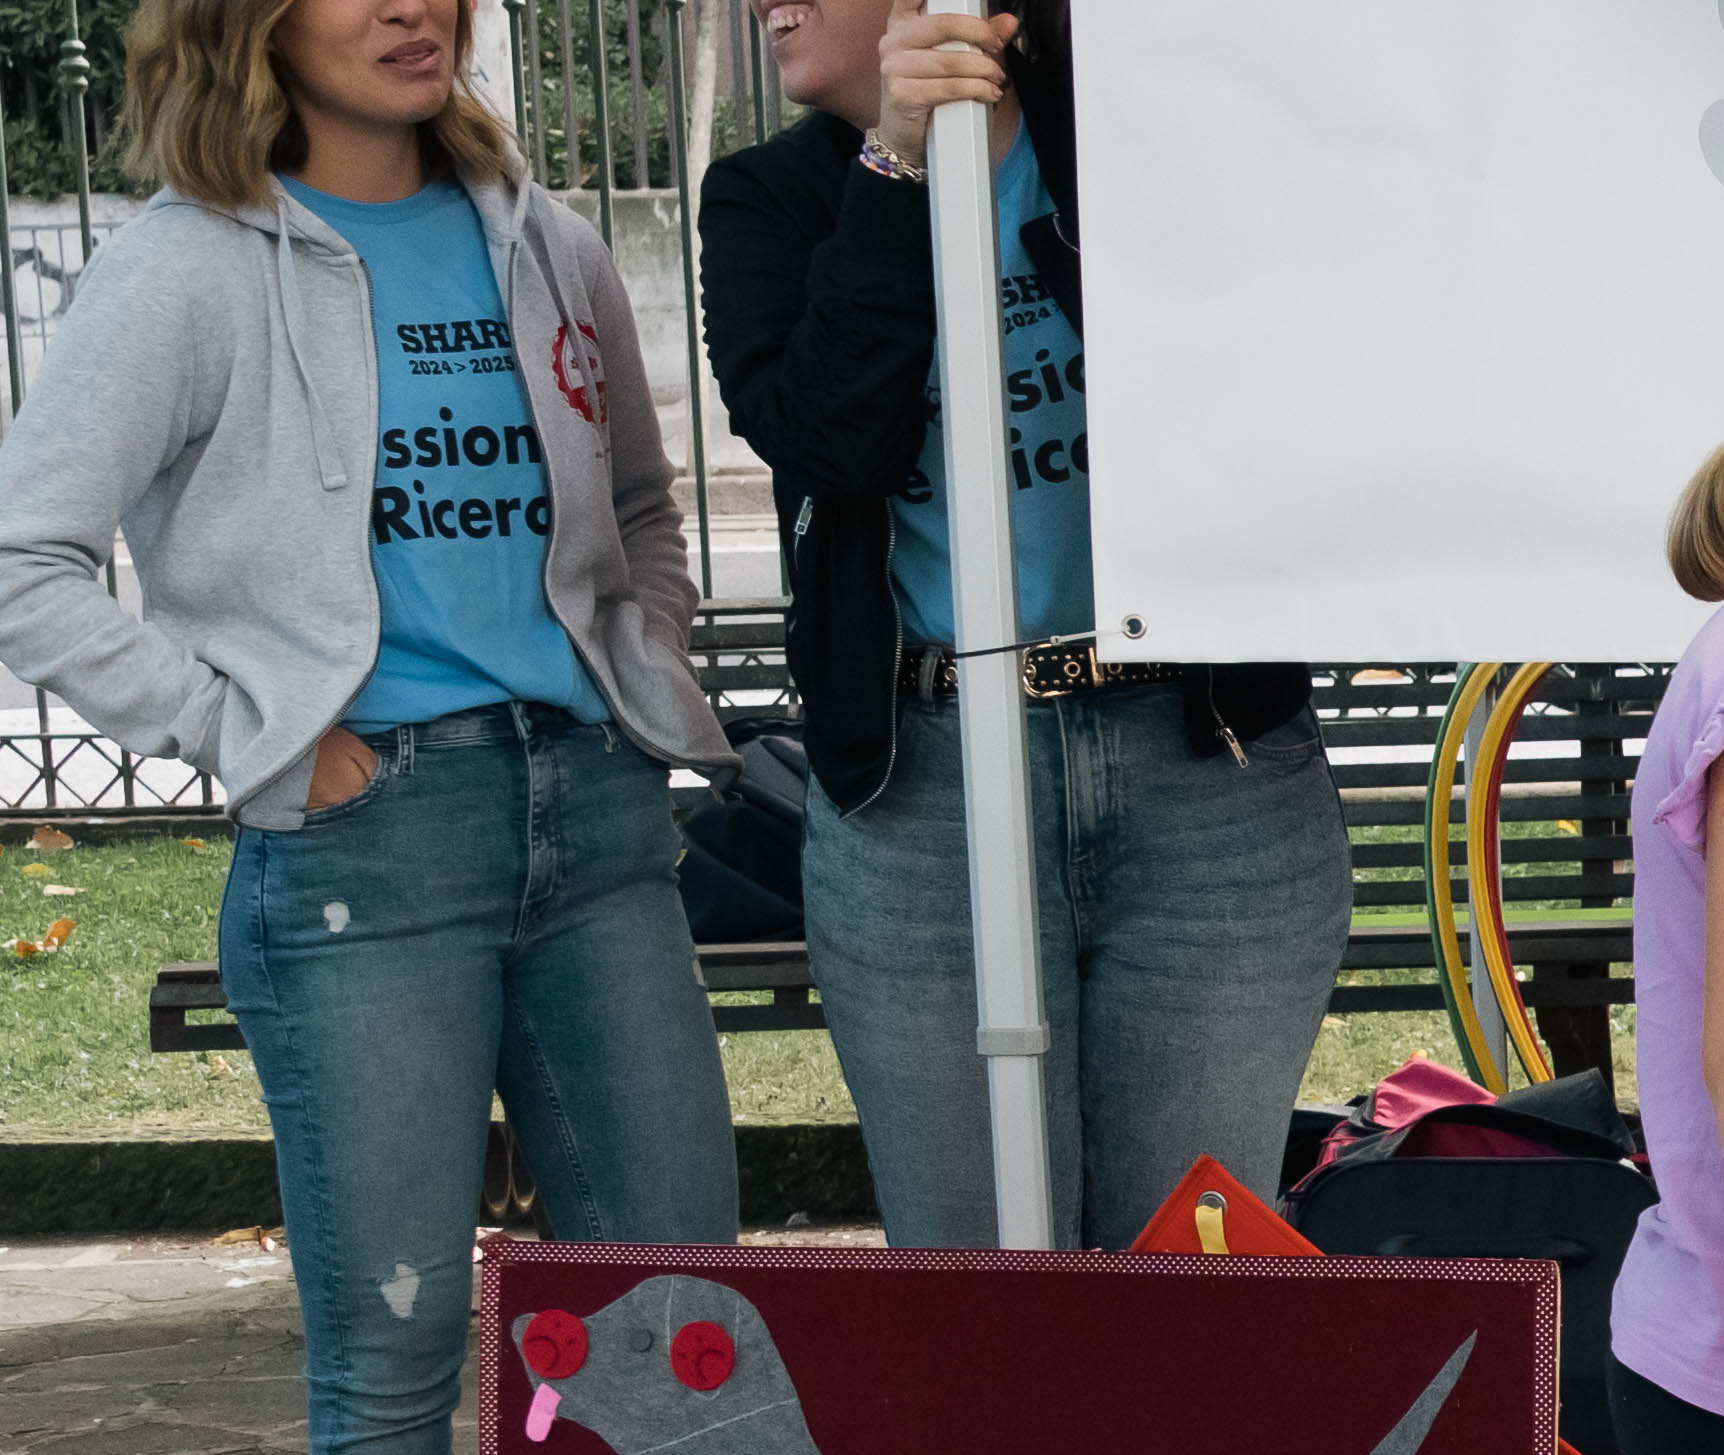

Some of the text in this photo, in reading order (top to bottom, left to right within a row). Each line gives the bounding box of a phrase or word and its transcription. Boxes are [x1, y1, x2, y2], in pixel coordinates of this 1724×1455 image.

[1003, 306, 1052, 336] 2024
[408, 360, 453, 375] 2024
[469, 355, 516, 374] 2025
[382, 406, 542, 469] ssion
